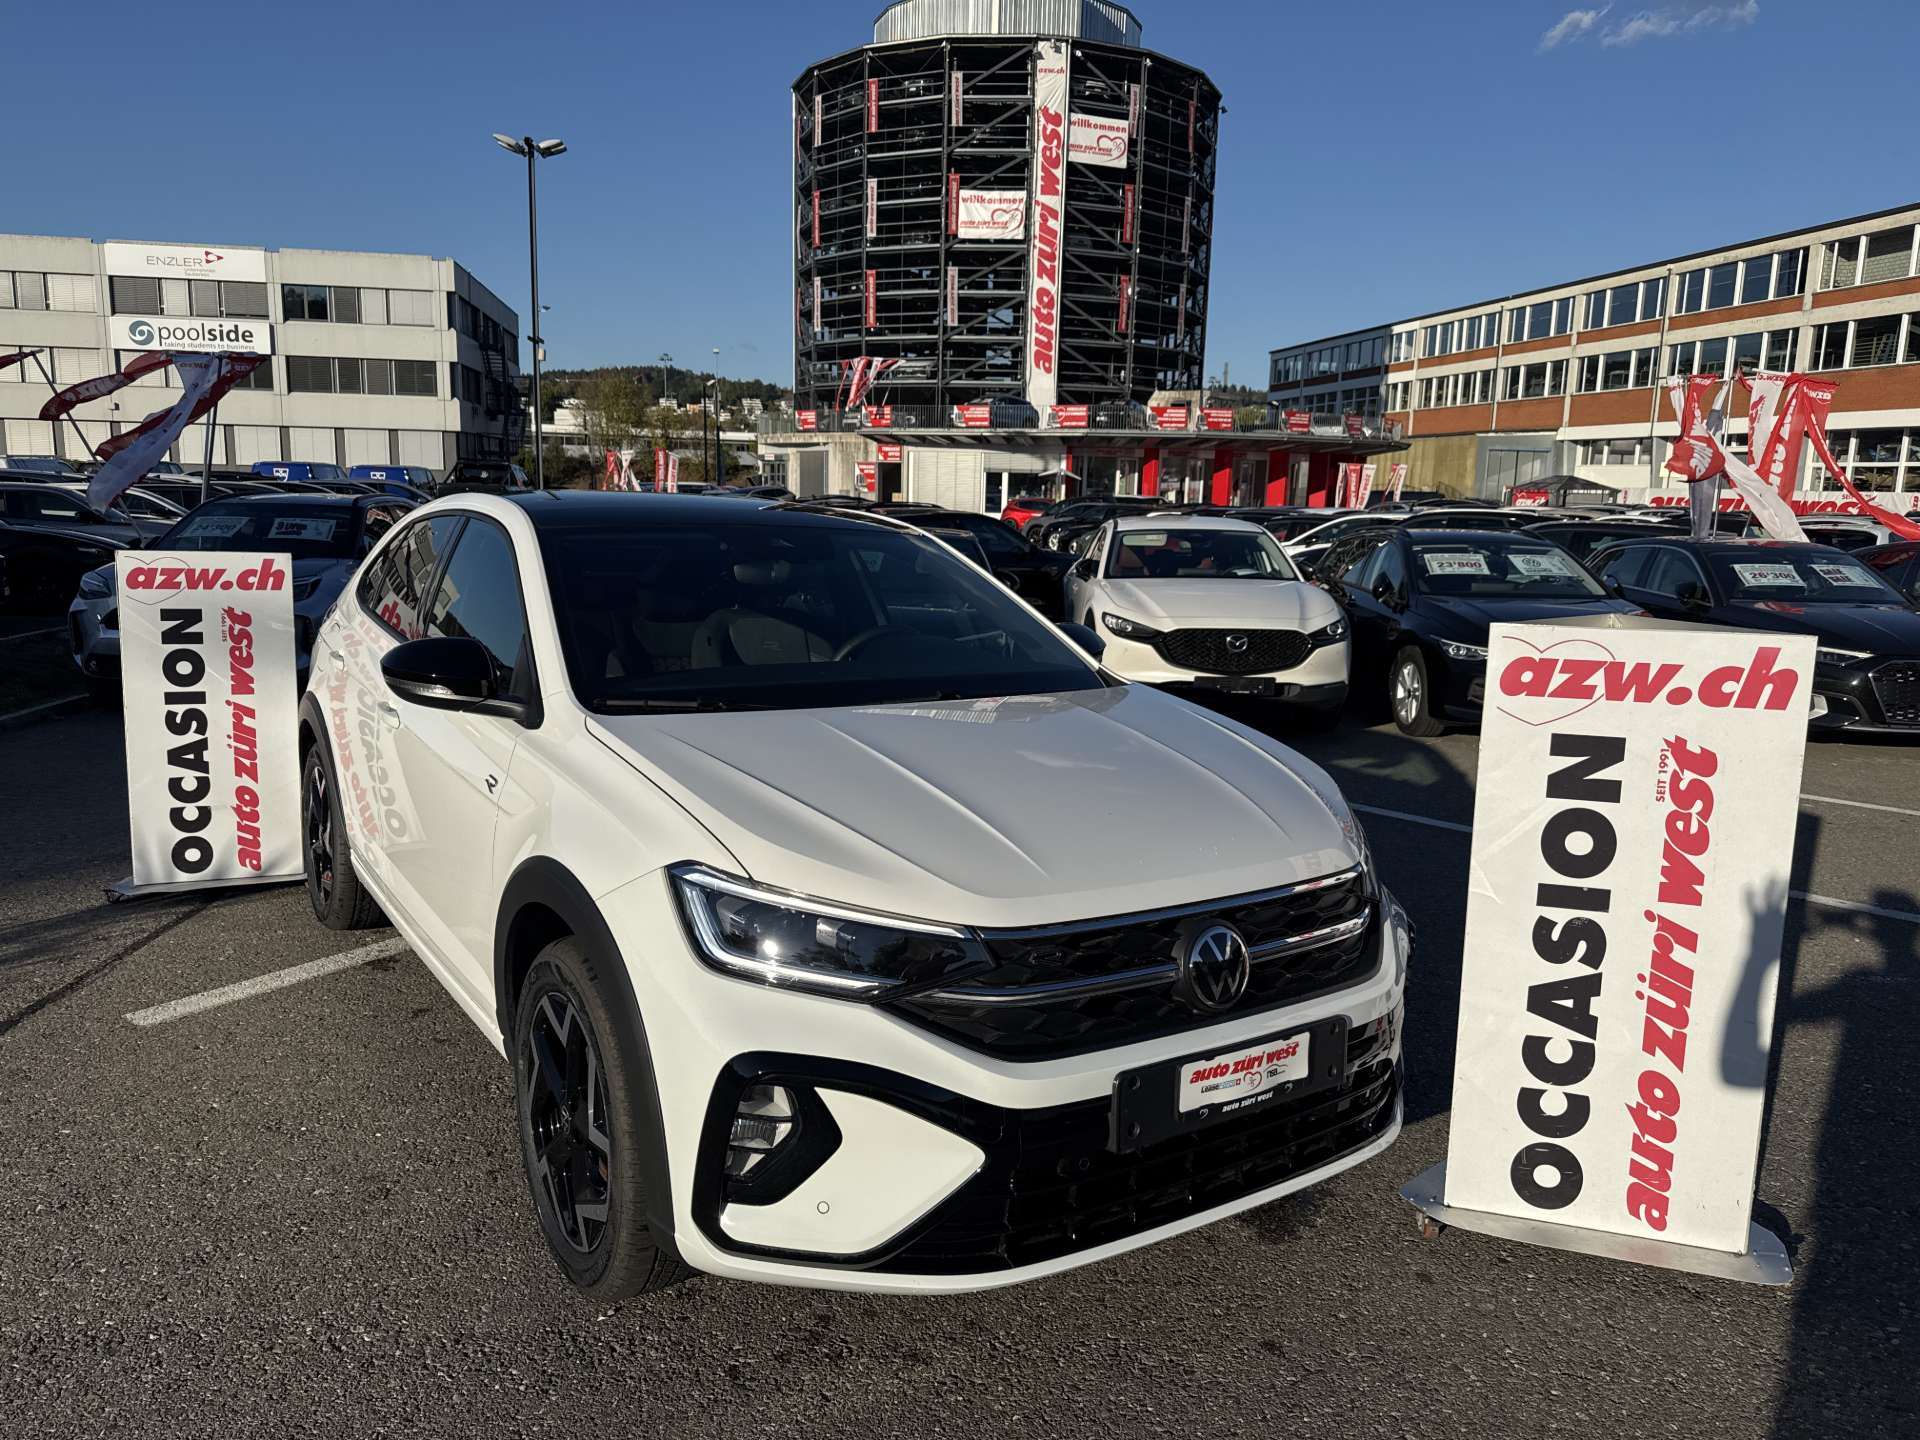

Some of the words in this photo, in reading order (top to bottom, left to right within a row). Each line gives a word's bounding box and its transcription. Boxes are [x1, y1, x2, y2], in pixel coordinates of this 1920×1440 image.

[1040, 105, 1063, 196] west
[1070, 117, 1127, 133] willkommen
[961, 194, 1025, 205] willkommen
[146, 255, 203, 267] ENZLER
[1034, 199, 1060, 287] züri
[158, 322, 254, 347] poolside
[164, 341, 186, 350] taking
[187, 341, 216, 349] students
[226, 343, 255, 351] business
[1033, 287, 1056, 374] auto
[125, 558, 286, 591] azw.ch
[1436, 561, 1483, 569] 23'800
[1749, 571, 1795, 580] 26'300
[221, 605, 256, 696] west
[1499, 646, 1800, 711] azw.ch
[160, 608, 214, 874] OCCASION
[225, 699, 260, 785] züri
[1658, 747, 1670, 775] 1991
[1655, 778, 1667, 803] SEIT
[231, 785, 262, 873] auto
[1658, 734, 1719, 907] west
[1510, 732, 1627, 1210] OCCASION
[1634, 909, 1699, 1074] züri
[1189, 1061, 1231, 1085] auto
[1230, 1050, 1265, 1076] züri
[1265, 1041, 1300, 1065] west
[1221, 1101, 1240, 1113] auto
[1257, 1090, 1274, 1102] west
[1626, 1069, 1681, 1232] auto
